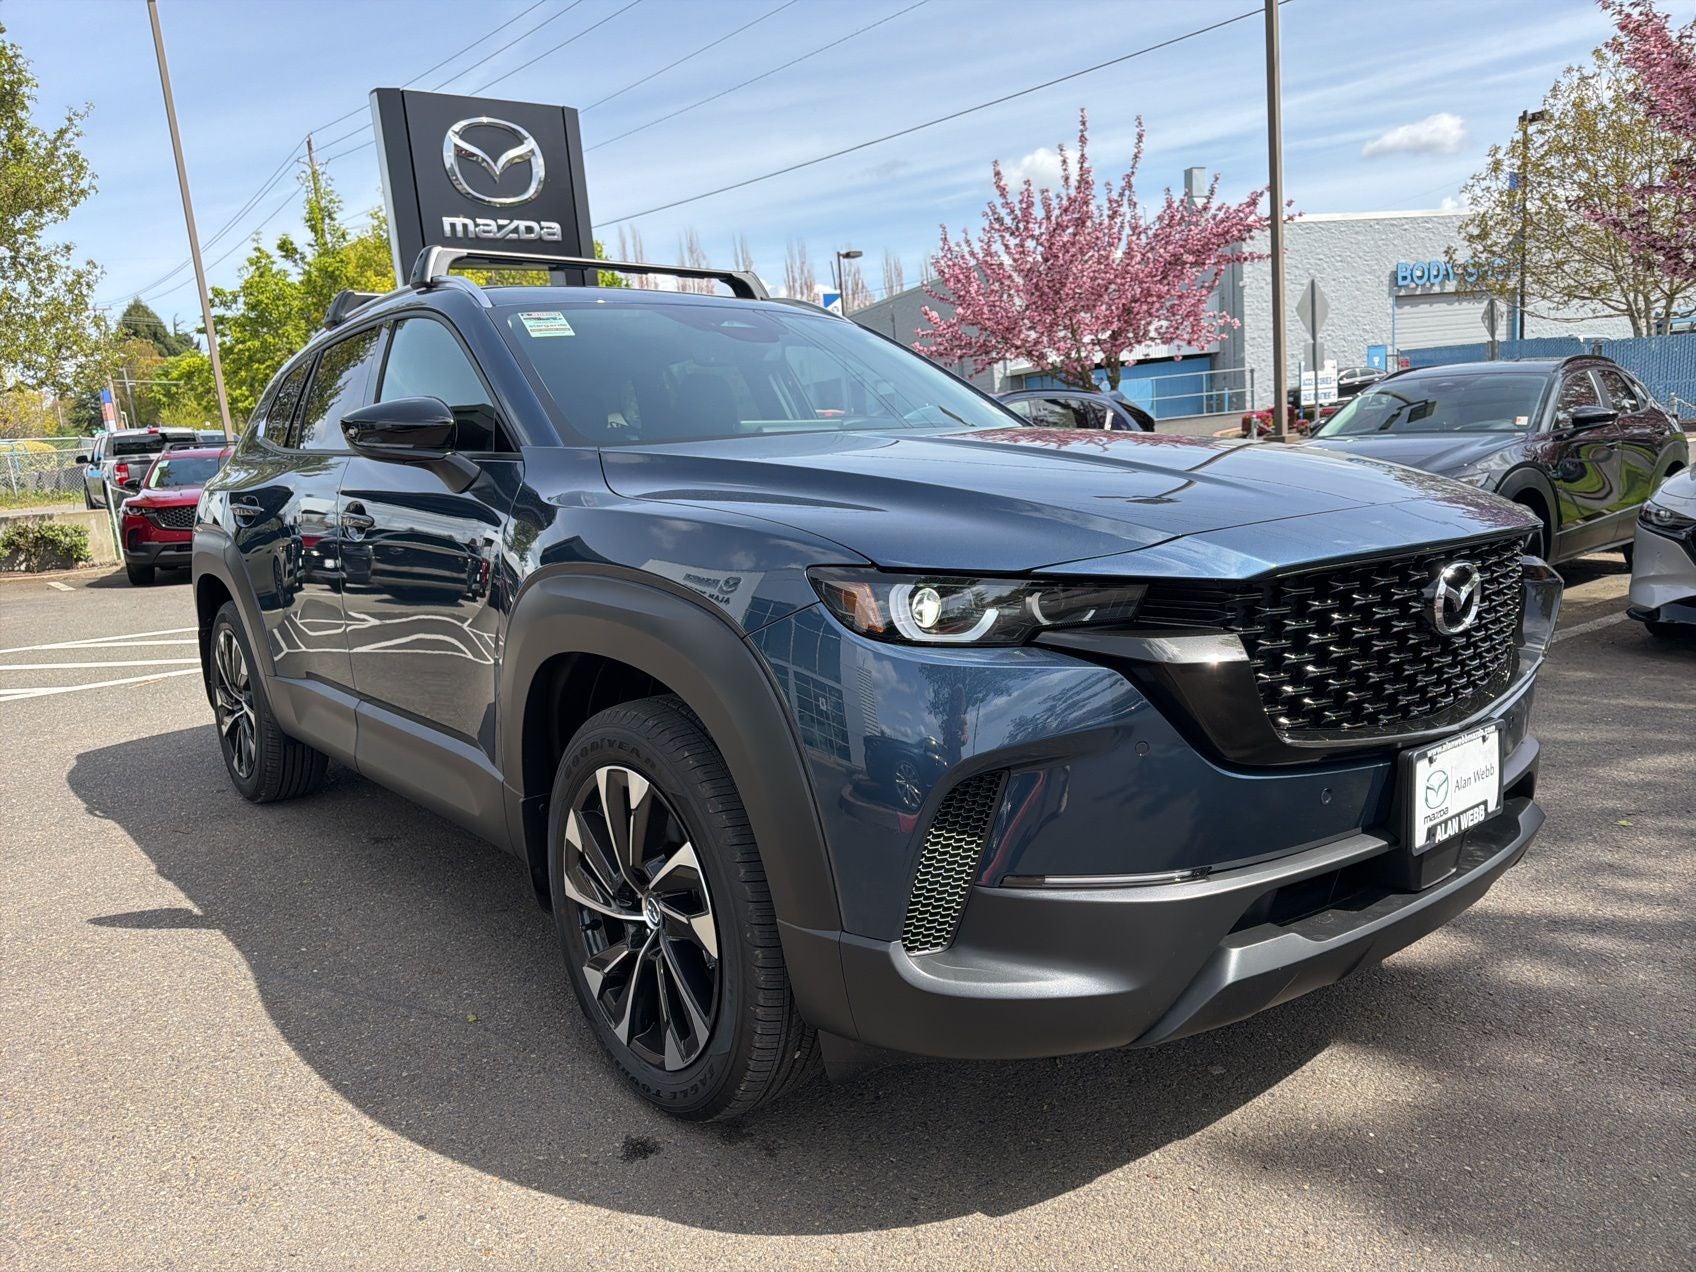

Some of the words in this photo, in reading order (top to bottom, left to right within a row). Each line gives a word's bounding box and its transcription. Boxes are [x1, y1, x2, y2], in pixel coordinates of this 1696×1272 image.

[1396, 261, 1455, 286] BODY
[1454, 776, 1472, 793] Alan
[1474, 763, 1495, 783] Webb
[1435, 816, 1459, 844] ALAN
[1459, 804, 1486, 830] WEBB
